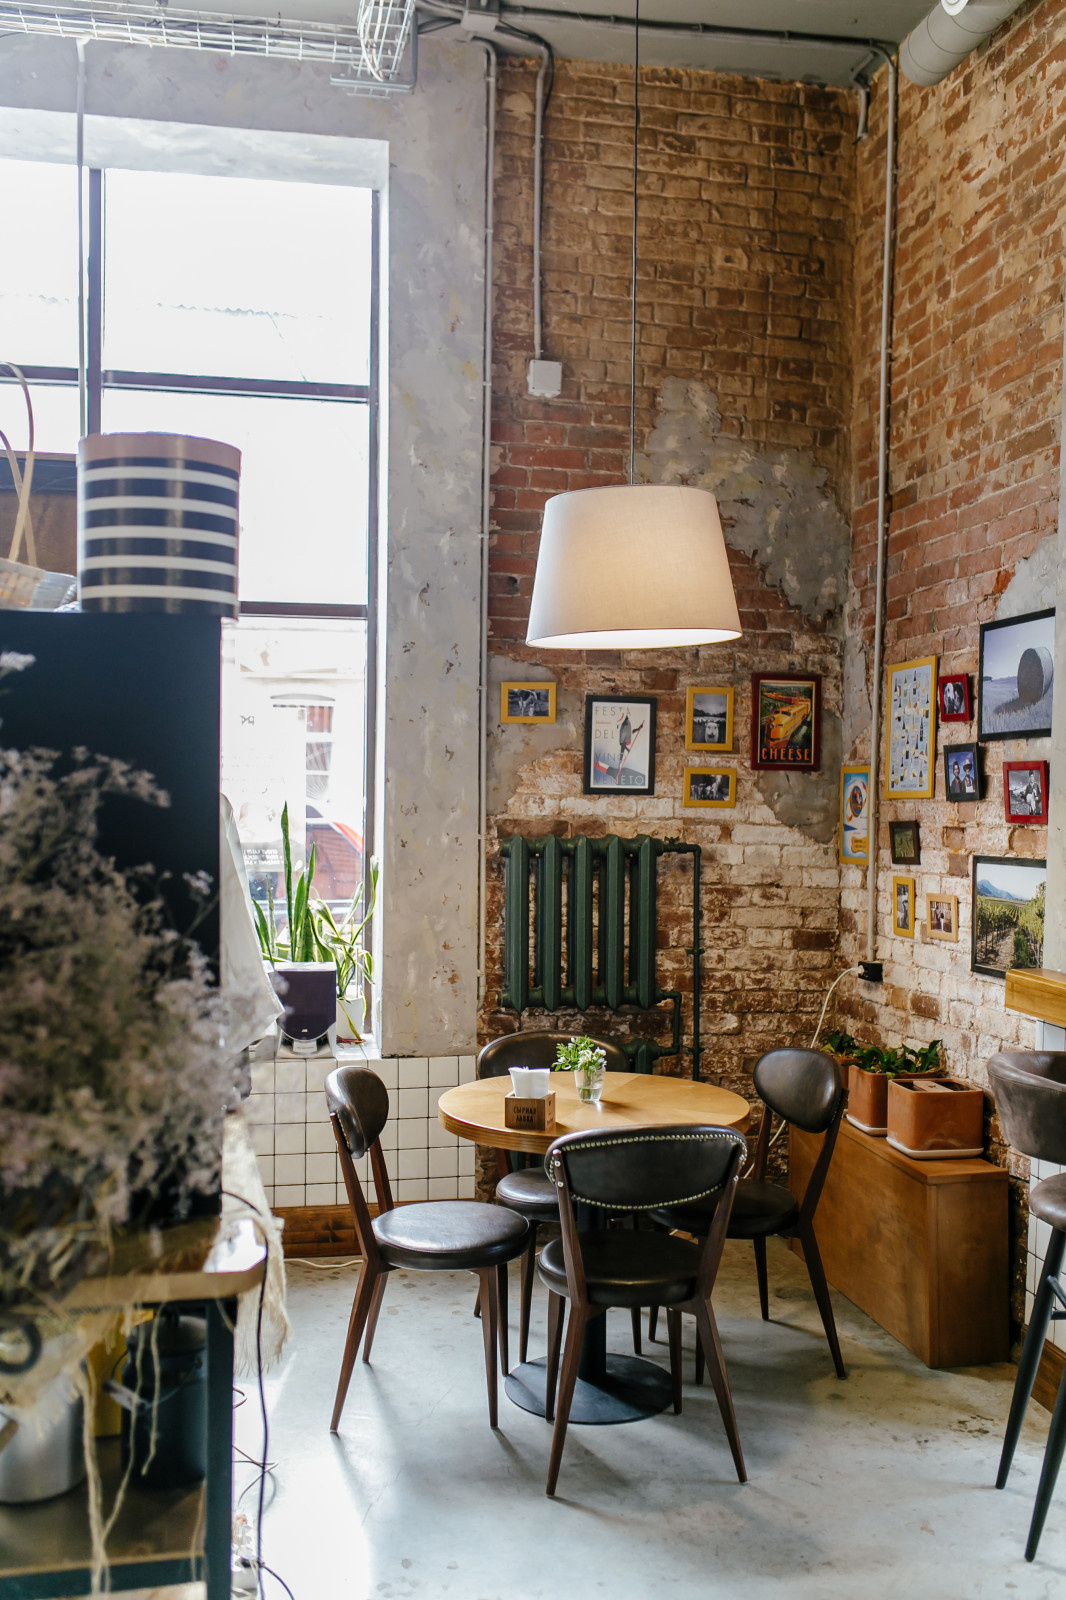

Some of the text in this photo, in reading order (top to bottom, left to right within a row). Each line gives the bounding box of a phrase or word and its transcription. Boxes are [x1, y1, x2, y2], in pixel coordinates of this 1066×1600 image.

[594, 706, 632, 717] FESTA
[594, 729, 615, 739] DEL
[761, 747, 810, 760] CHEESE
[513, 1106, 537, 1115] СЫРНАЯ
